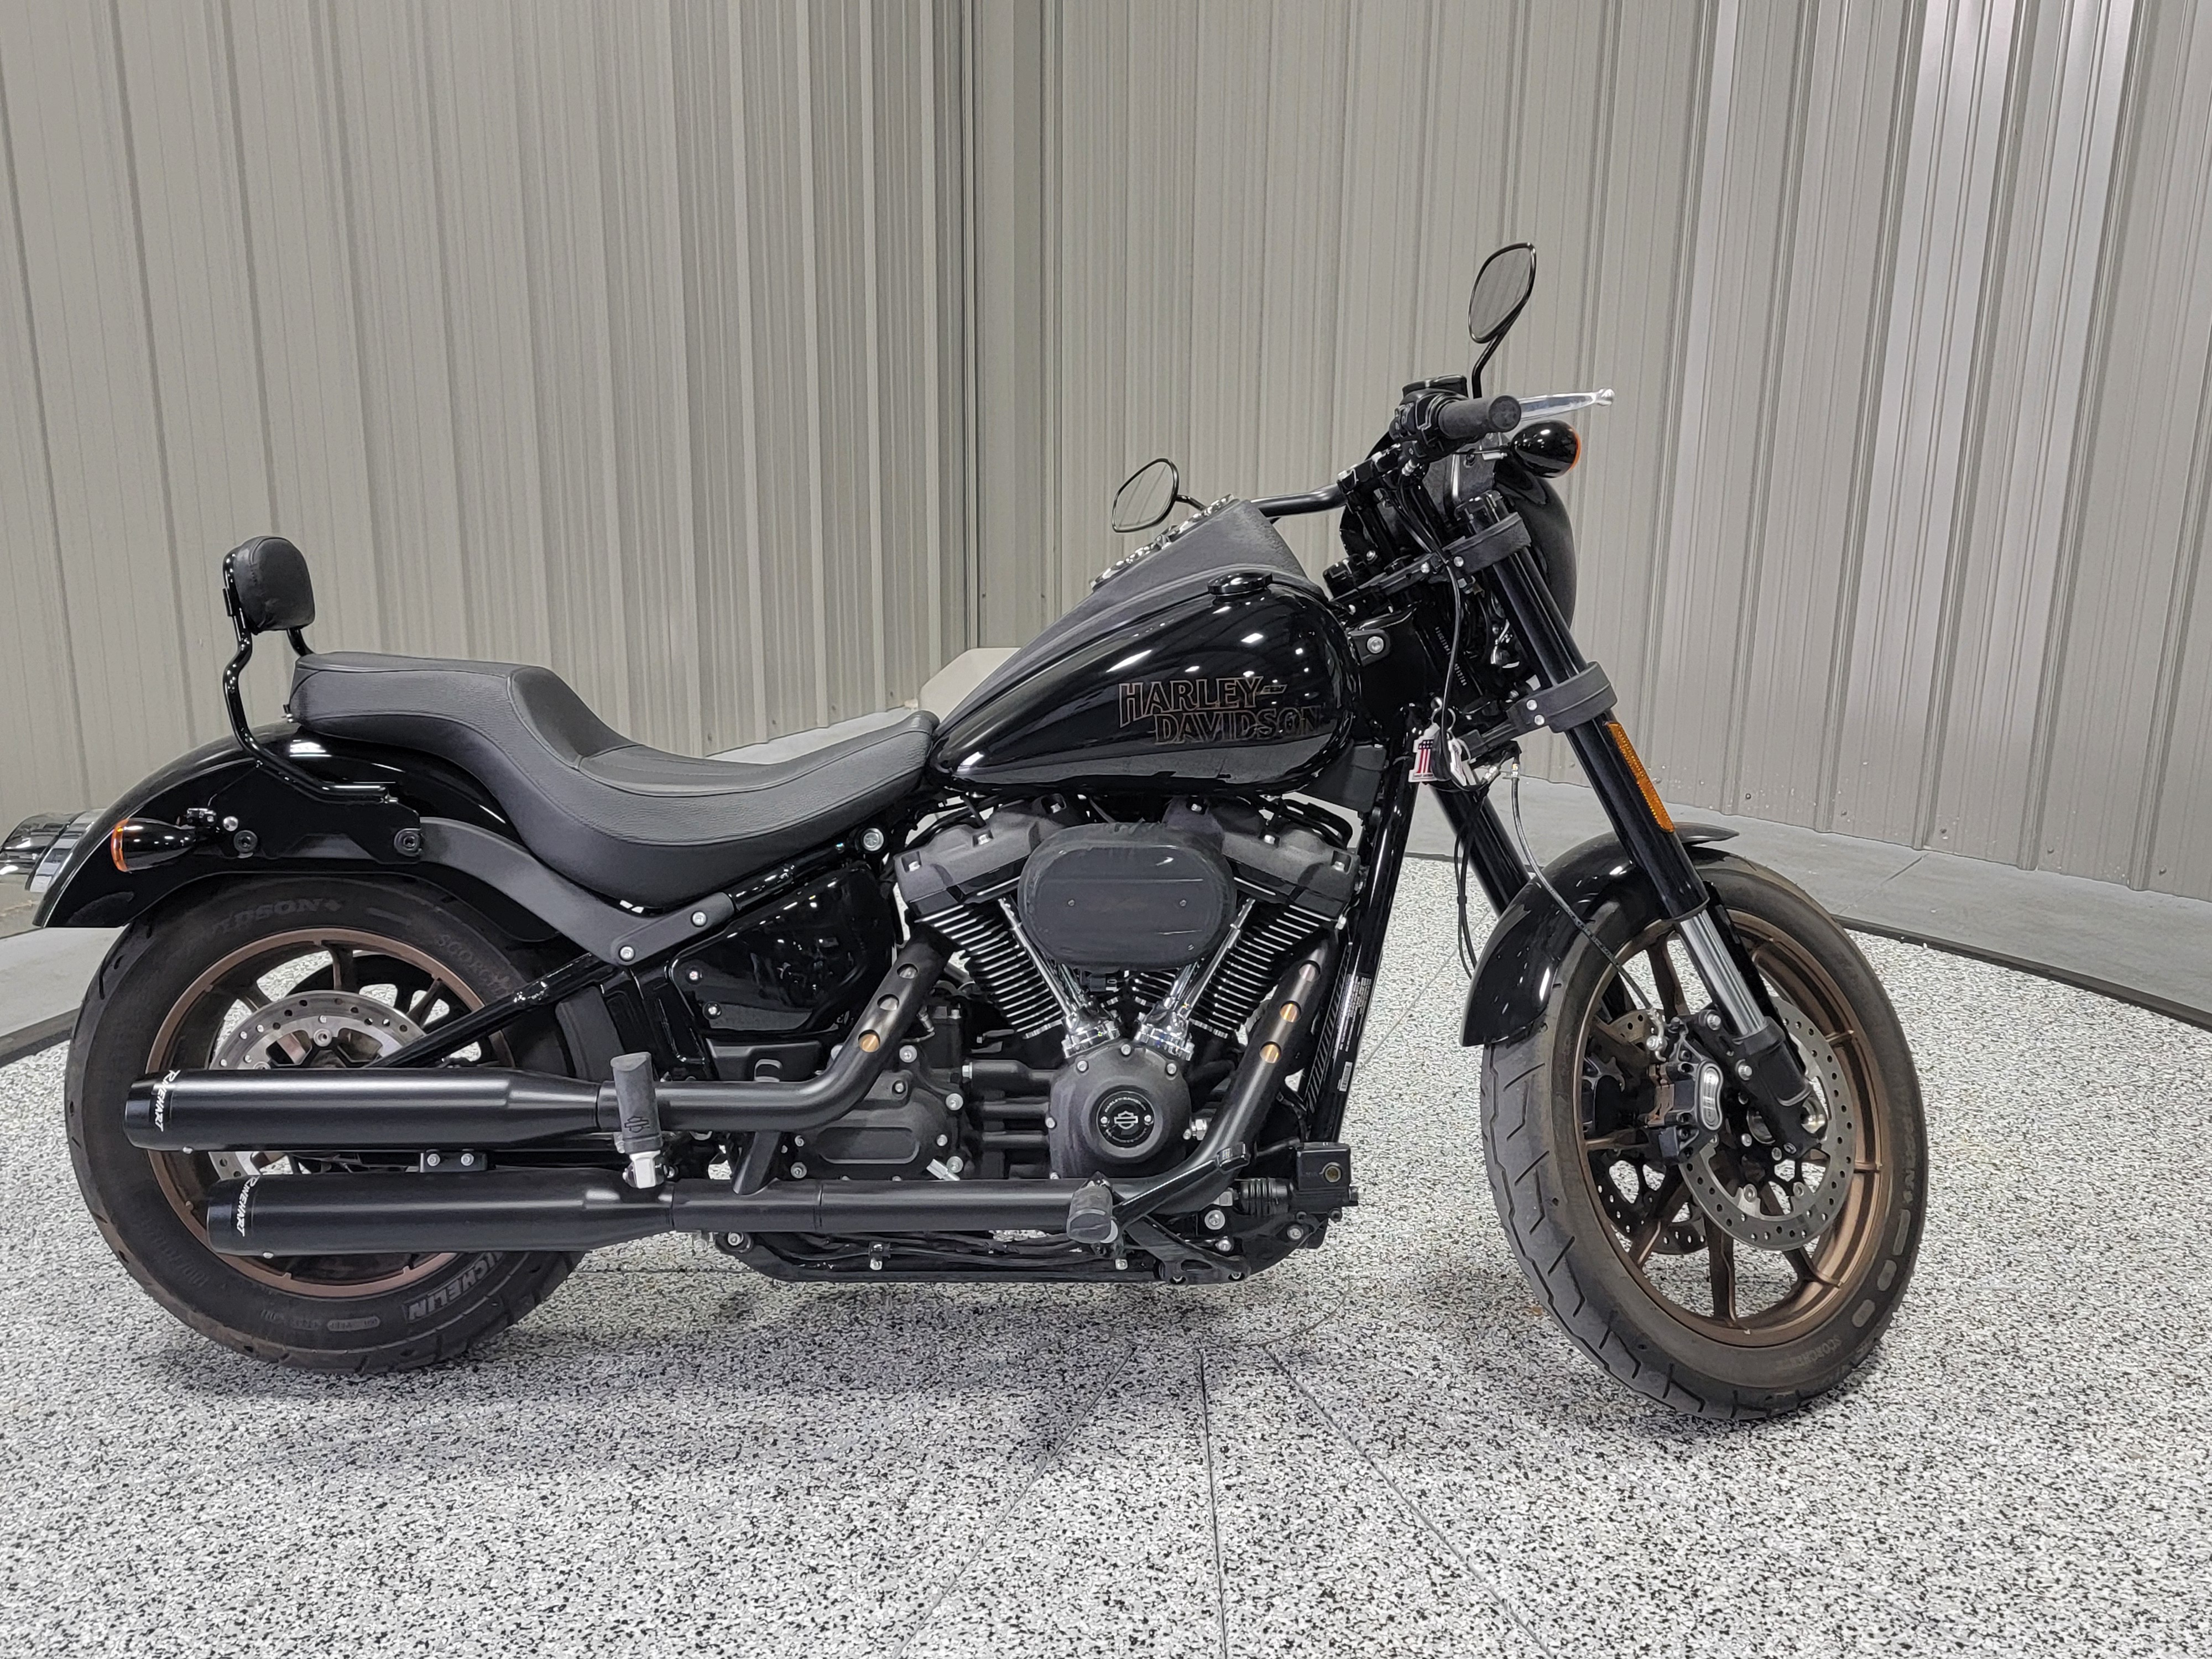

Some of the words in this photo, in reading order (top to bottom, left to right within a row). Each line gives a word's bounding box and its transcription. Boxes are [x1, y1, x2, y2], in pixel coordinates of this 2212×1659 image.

[1152, 703, 1326, 745] DAVIDSON
[155, 1070, 181, 1132] RINEHART
[236, 1176, 260, 1237] RINEHART
